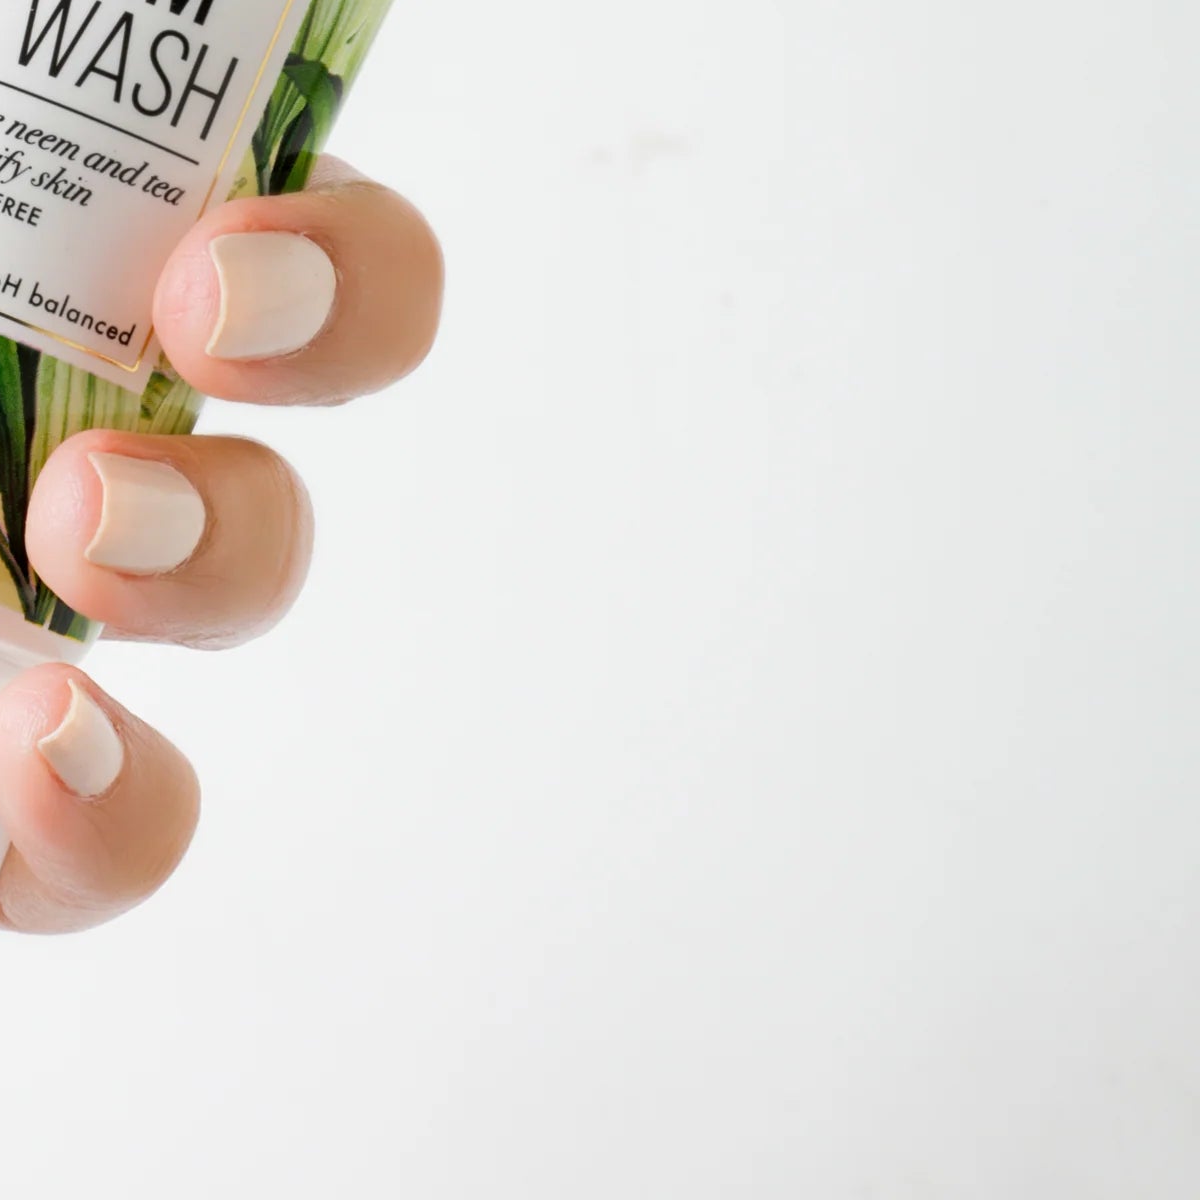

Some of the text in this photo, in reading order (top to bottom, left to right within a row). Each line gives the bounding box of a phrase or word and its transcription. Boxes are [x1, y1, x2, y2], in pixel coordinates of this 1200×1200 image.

[5, 119, 81, 161] neem
[83, 149, 150, 187] and
[143, 177, 187, 206] tea
[30, 168, 95, 207] skin
[29, 281, 137, 346] balanced
